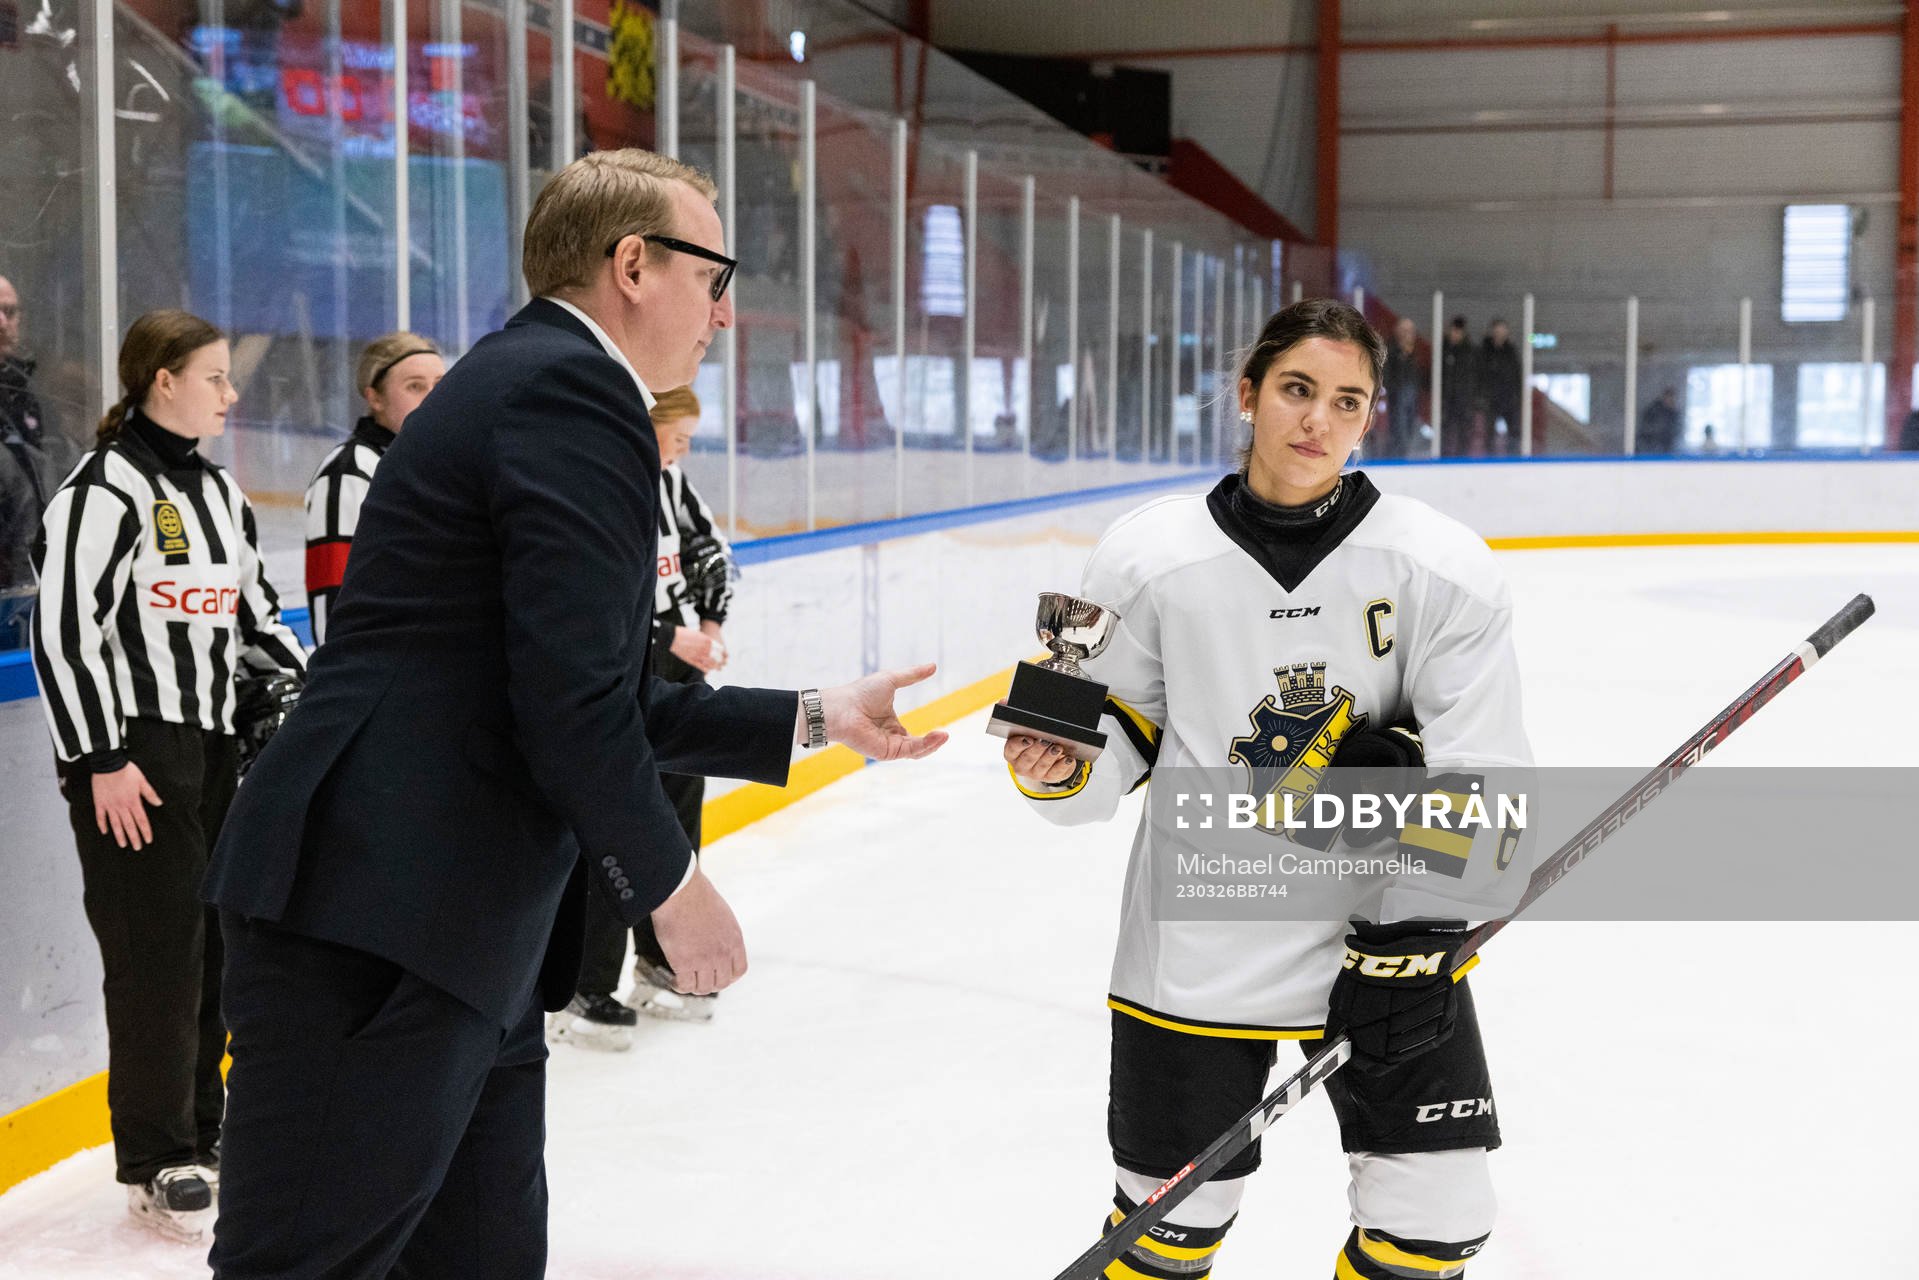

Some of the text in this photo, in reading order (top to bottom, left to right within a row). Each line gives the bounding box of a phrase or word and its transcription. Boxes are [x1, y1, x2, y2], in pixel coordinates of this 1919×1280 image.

[1268, 606, 1321, 619] CCM
[1363, 597, 1395, 661] C
[1562, 731, 1718, 873] JETSPEED
[1342, 944, 1447, 978] CCM
[1249, 1040, 1352, 1143] CM
[1415, 1098, 1494, 1124] CCM
[1151, 1165, 1191, 1202] CCM
[1148, 1225, 1188, 1242] CM
